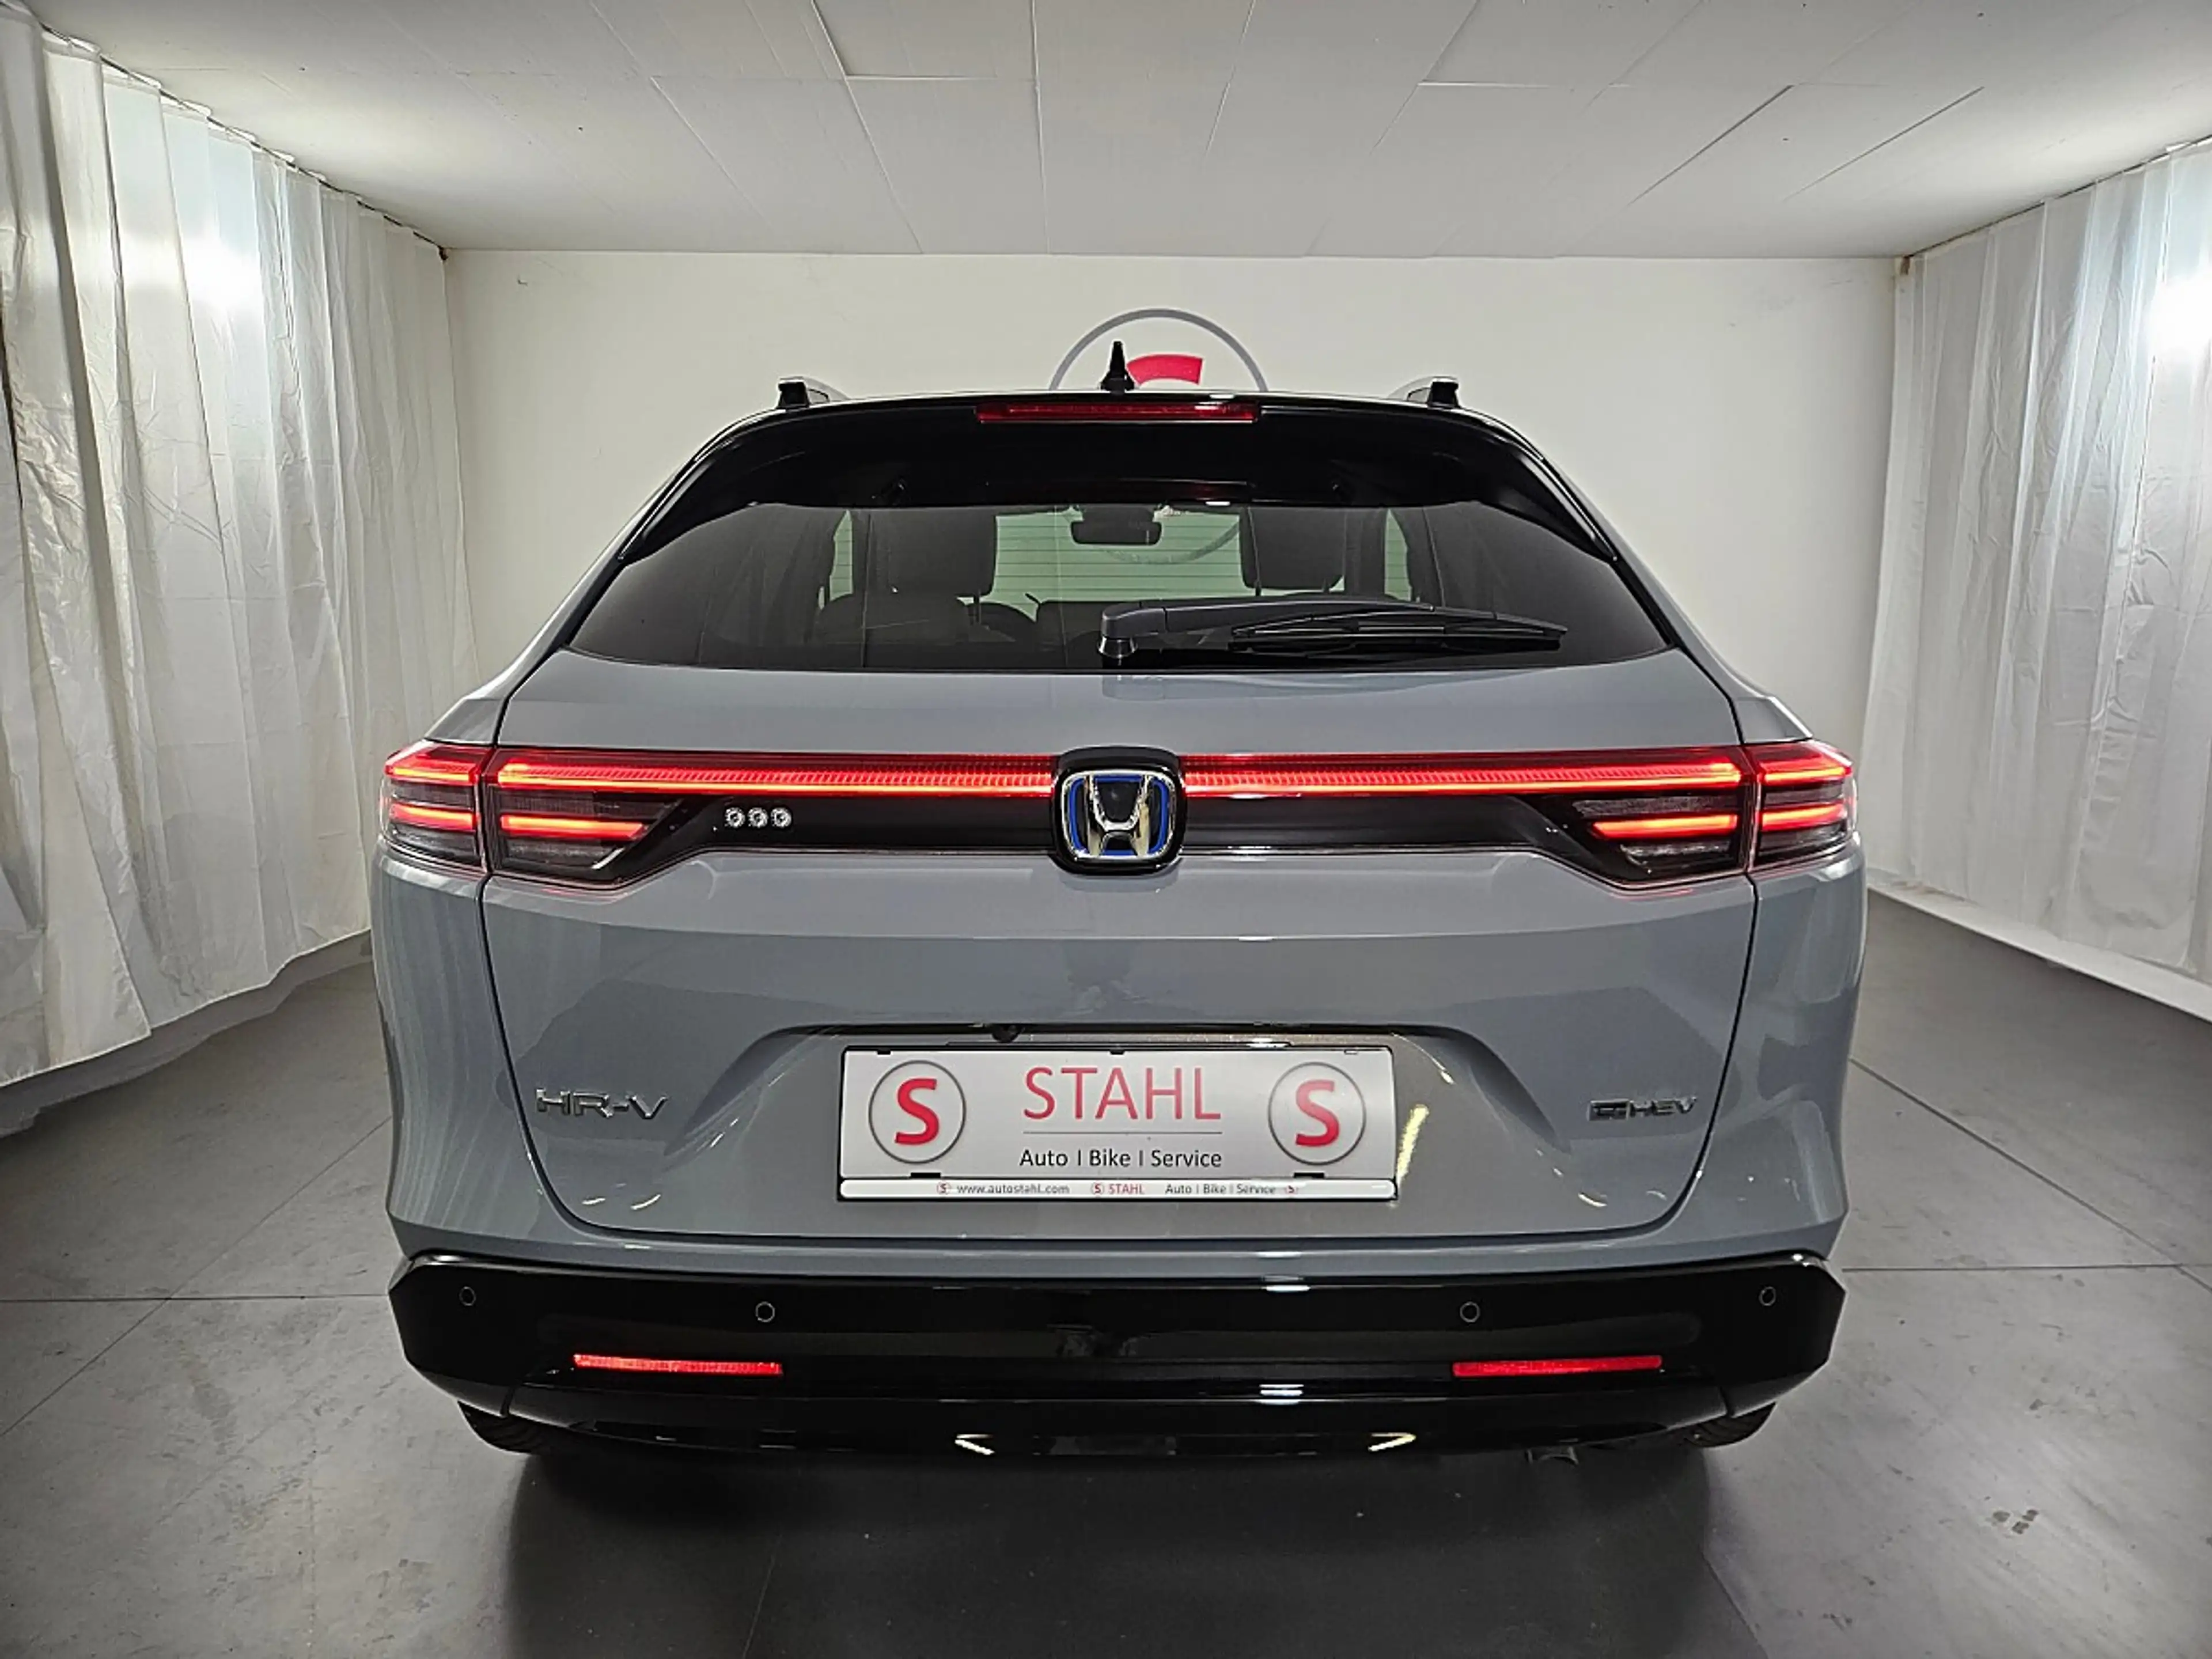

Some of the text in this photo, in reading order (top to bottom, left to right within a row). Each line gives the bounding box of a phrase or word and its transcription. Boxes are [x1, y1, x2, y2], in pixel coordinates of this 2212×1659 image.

[536, 1088, 668, 1119] HR-V
[1023, 1066, 1222, 1120] STAHL
[894, 1077, 940, 1146] S
[1294, 1079, 1341, 1148] S
[1019, 1149, 1068, 1166] Auto
[1089, 1148, 1131, 1167] Bike
[1150, 1149, 1222, 1168] Service
[956, 1183, 1070, 1195] www.autostahl.com
[1108, 1183, 1145, 1195] STAHL
[1165, 1183, 1192, 1194] Auto
[1203, 1183, 1227, 1195] Bike
[1236, 1184, 1277, 1195] Service
